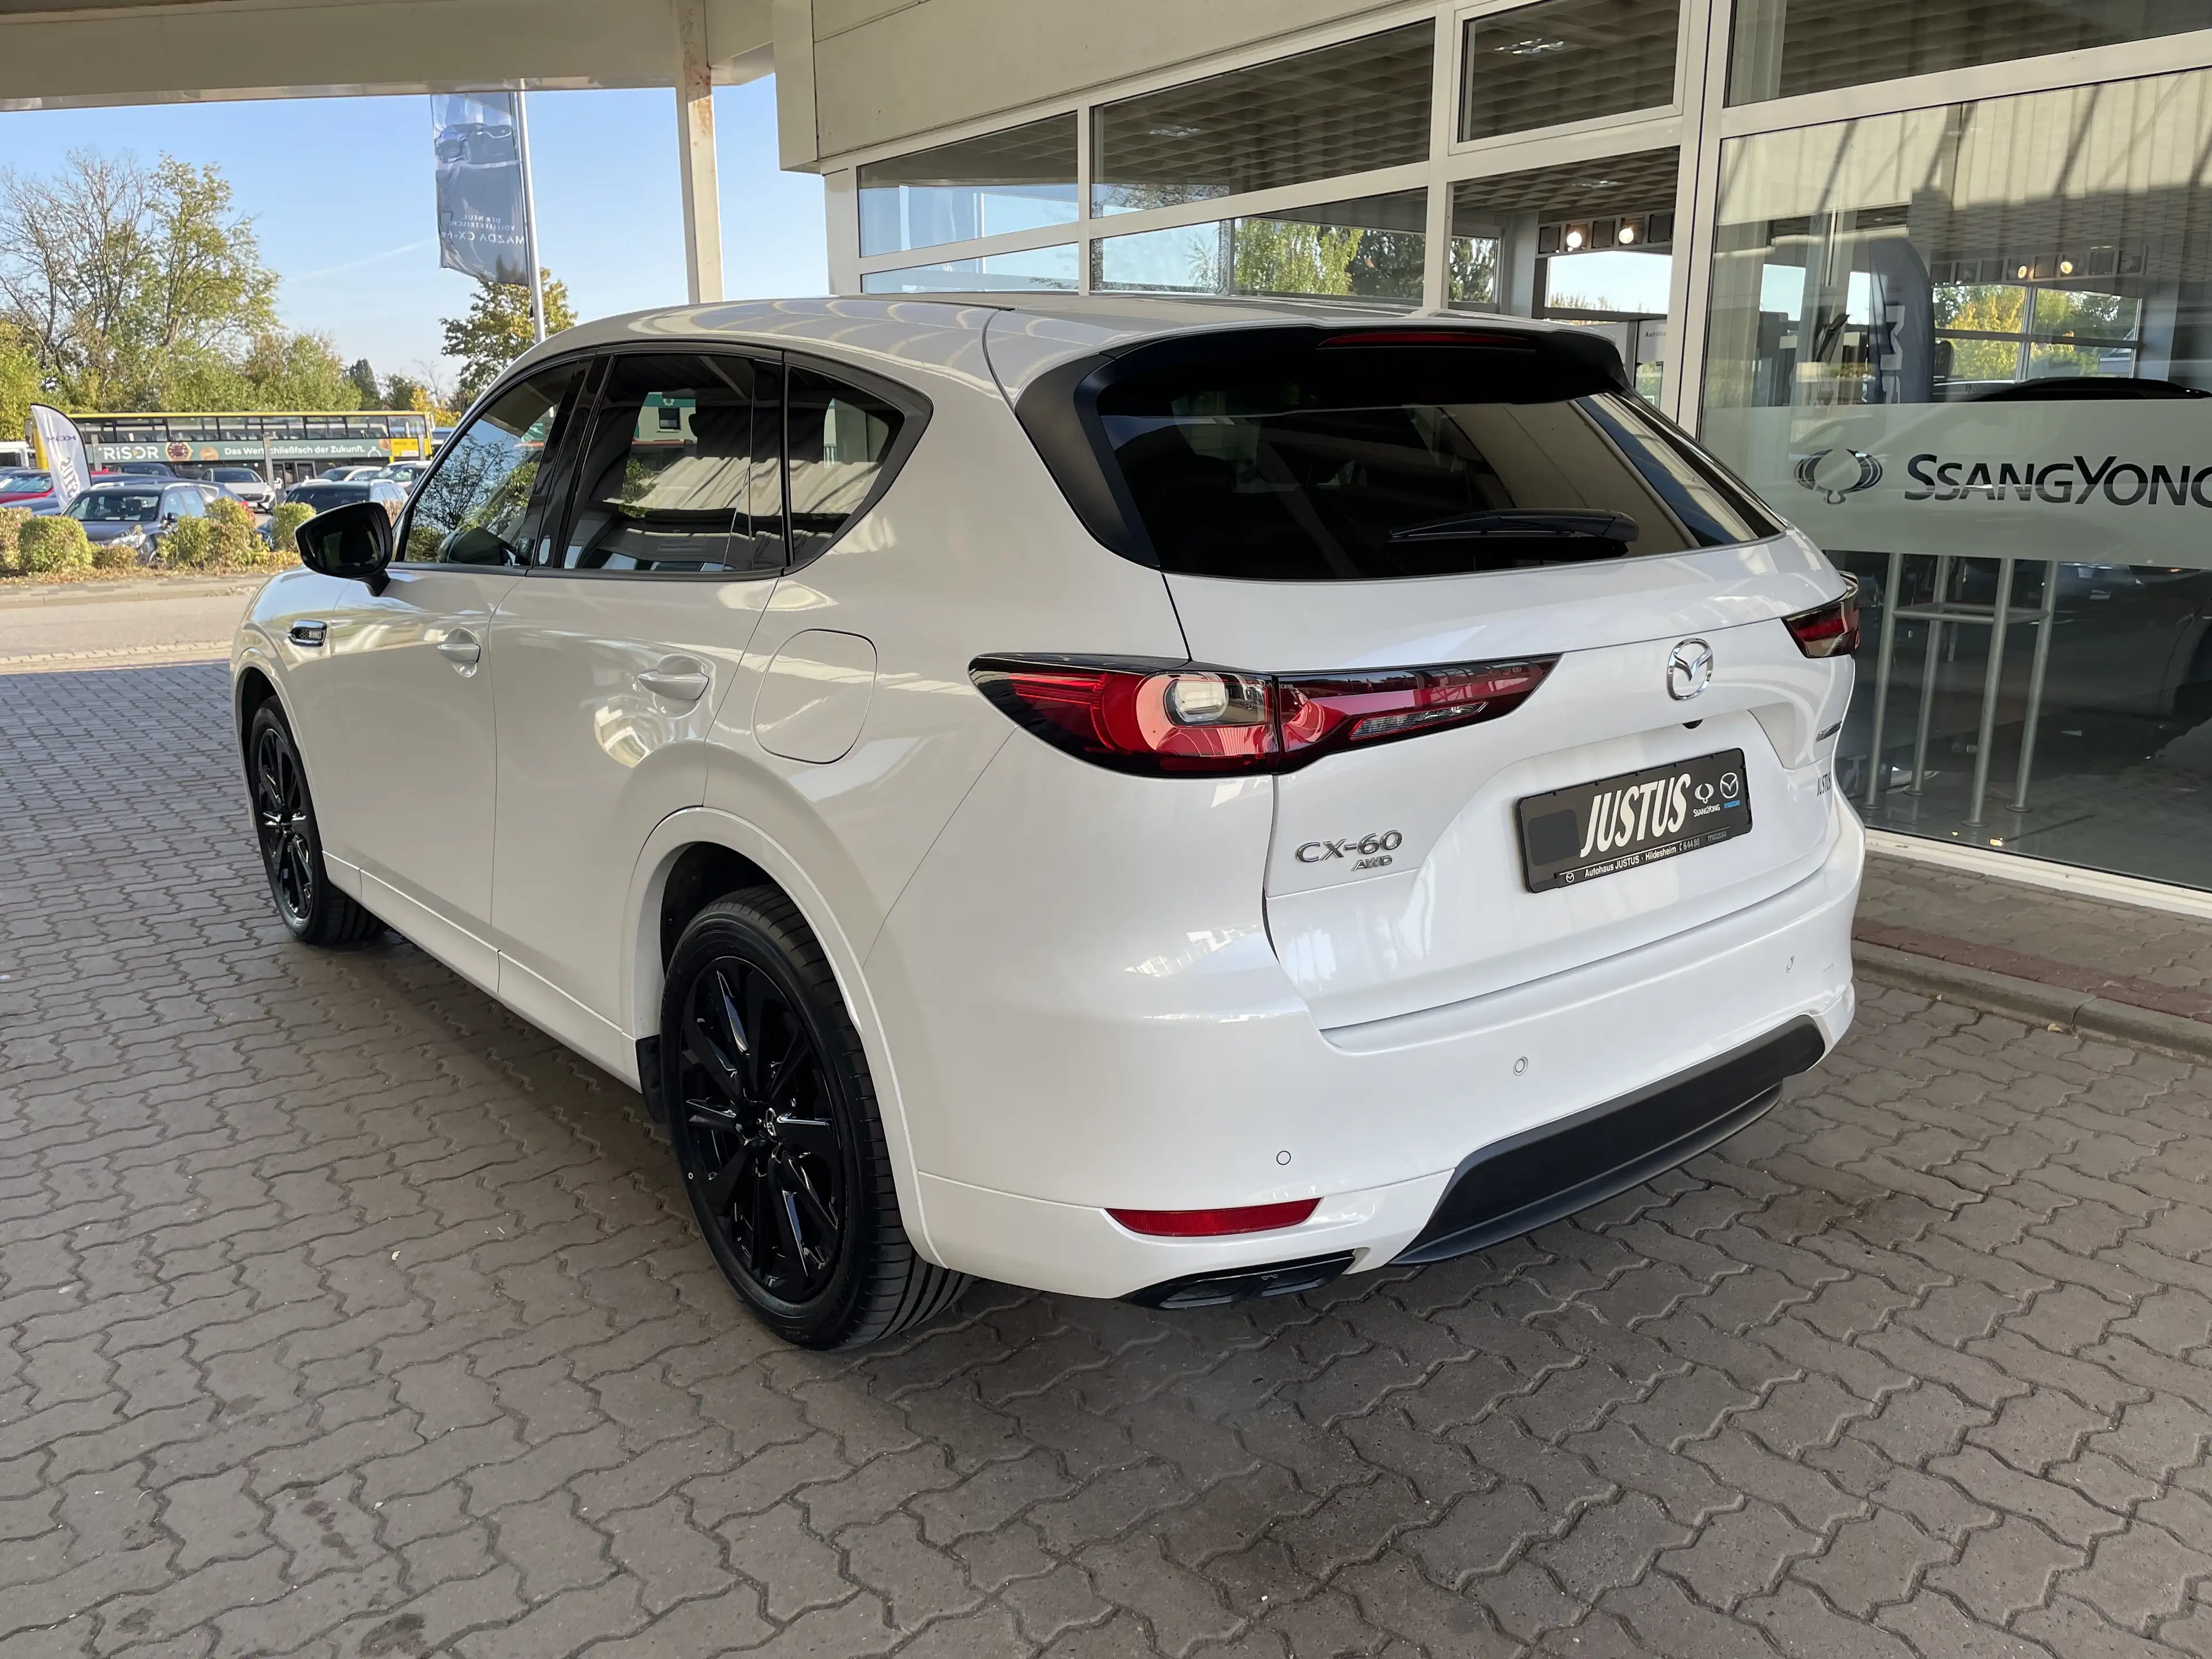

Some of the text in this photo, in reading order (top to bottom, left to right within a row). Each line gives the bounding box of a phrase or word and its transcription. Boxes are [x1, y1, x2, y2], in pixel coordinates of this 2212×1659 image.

[243, 445, 315, 455] Wertchließfach
[331, 445, 366, 453] Zukunft.
[1580, 773, 1691, 858] JUSTUS
[1693, 804, 1721, 818] SSANGYONG
[1295, 830, 1403, 863] CX-60
[1351, 855, 1393, 872] AWD
[1585, 864, 1614, 878] Autohaus
[1615, 855, 1640, 870] JUSTUS
[1645, 845, 1677, 861] Hildesheim
